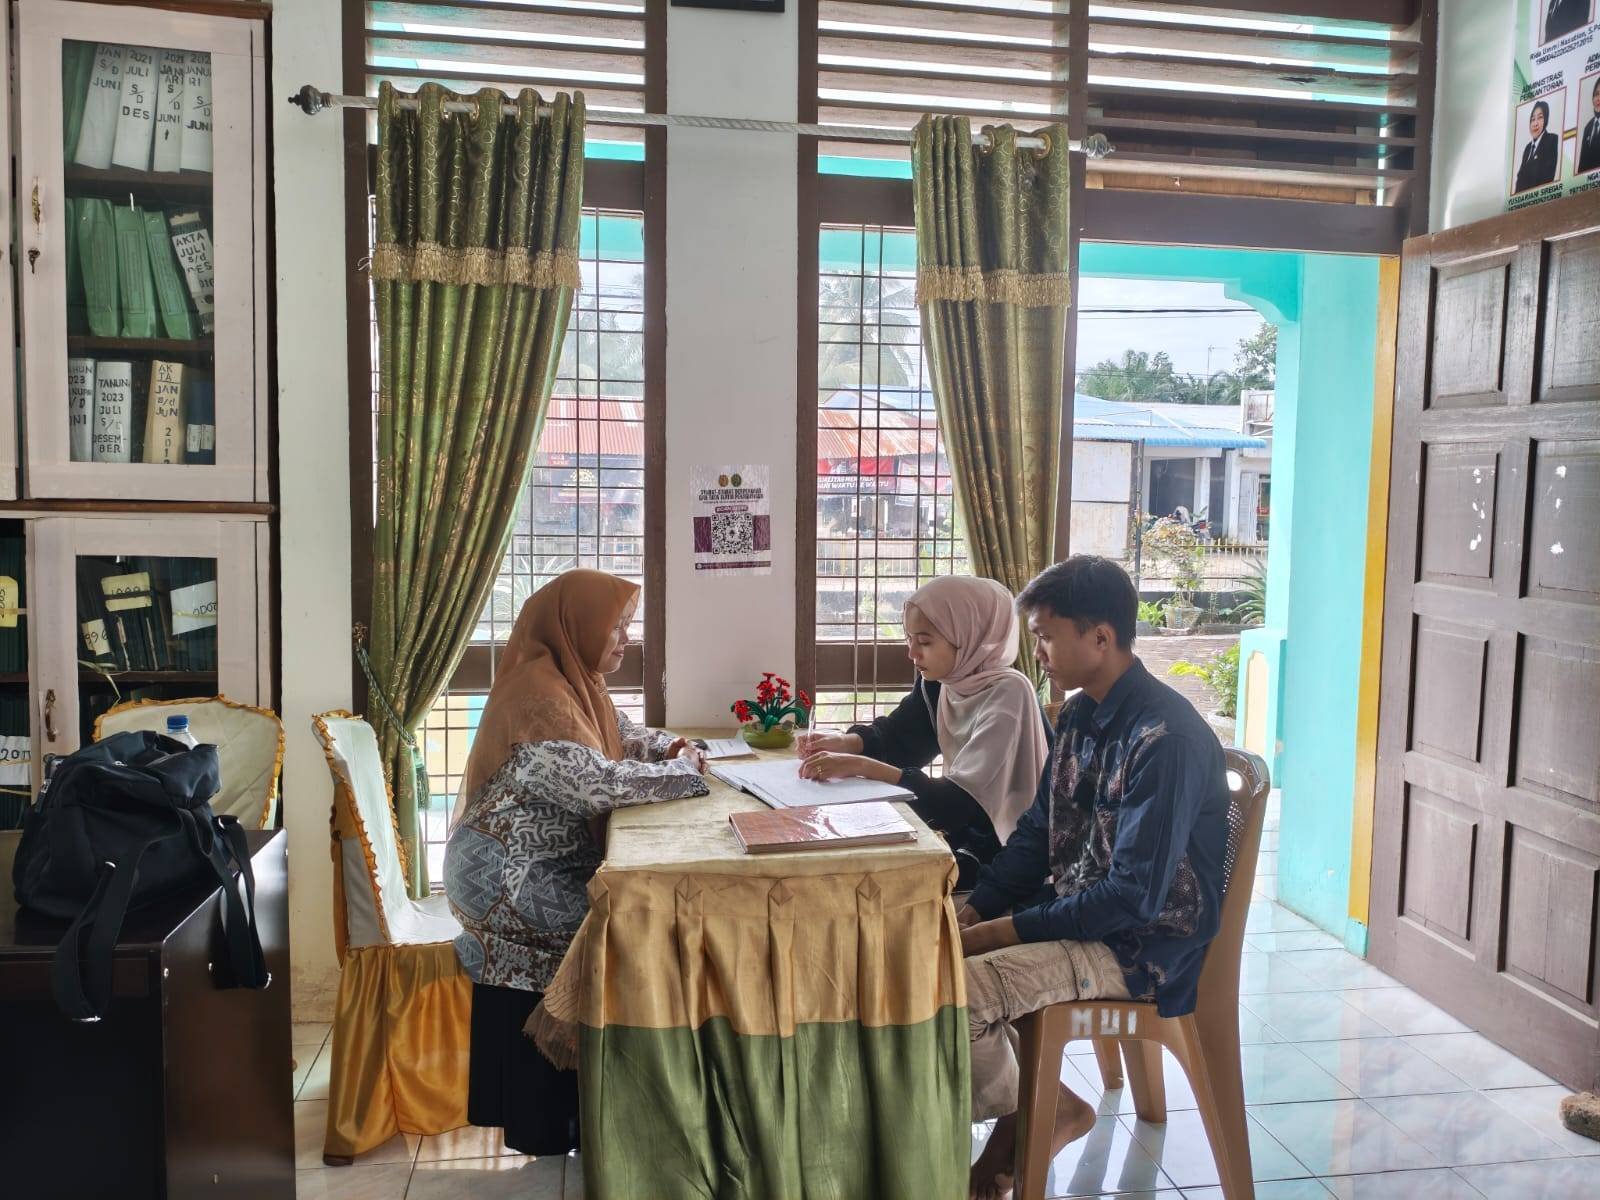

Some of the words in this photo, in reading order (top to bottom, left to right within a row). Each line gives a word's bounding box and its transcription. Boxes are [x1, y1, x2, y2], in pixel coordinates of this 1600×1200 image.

[129, 50, 152, 65] 2021
[125, 65, 149, 78] JULI
[93, 77, 121, 91] JUNI
[1521, 71, 1564, 95] ADMINISTRASI
[1519, 80, 1564, 102] PERKANTORAN
[122, 106, 150, 120] DES
[157, 113, 181, 125] JUNI
[176, 231, 205, 247] AKTA
[180, 241, 206, 258] JULI
[101, 391, 124, 402] 2023
[155, 385, 178, 394] JAN
[99, 405, 121, 415] JULI
[155, 406, 178, 418] JUN
[99, 444, 121, 454] BER
[1071, 1007, 1138, 1037] MUI
